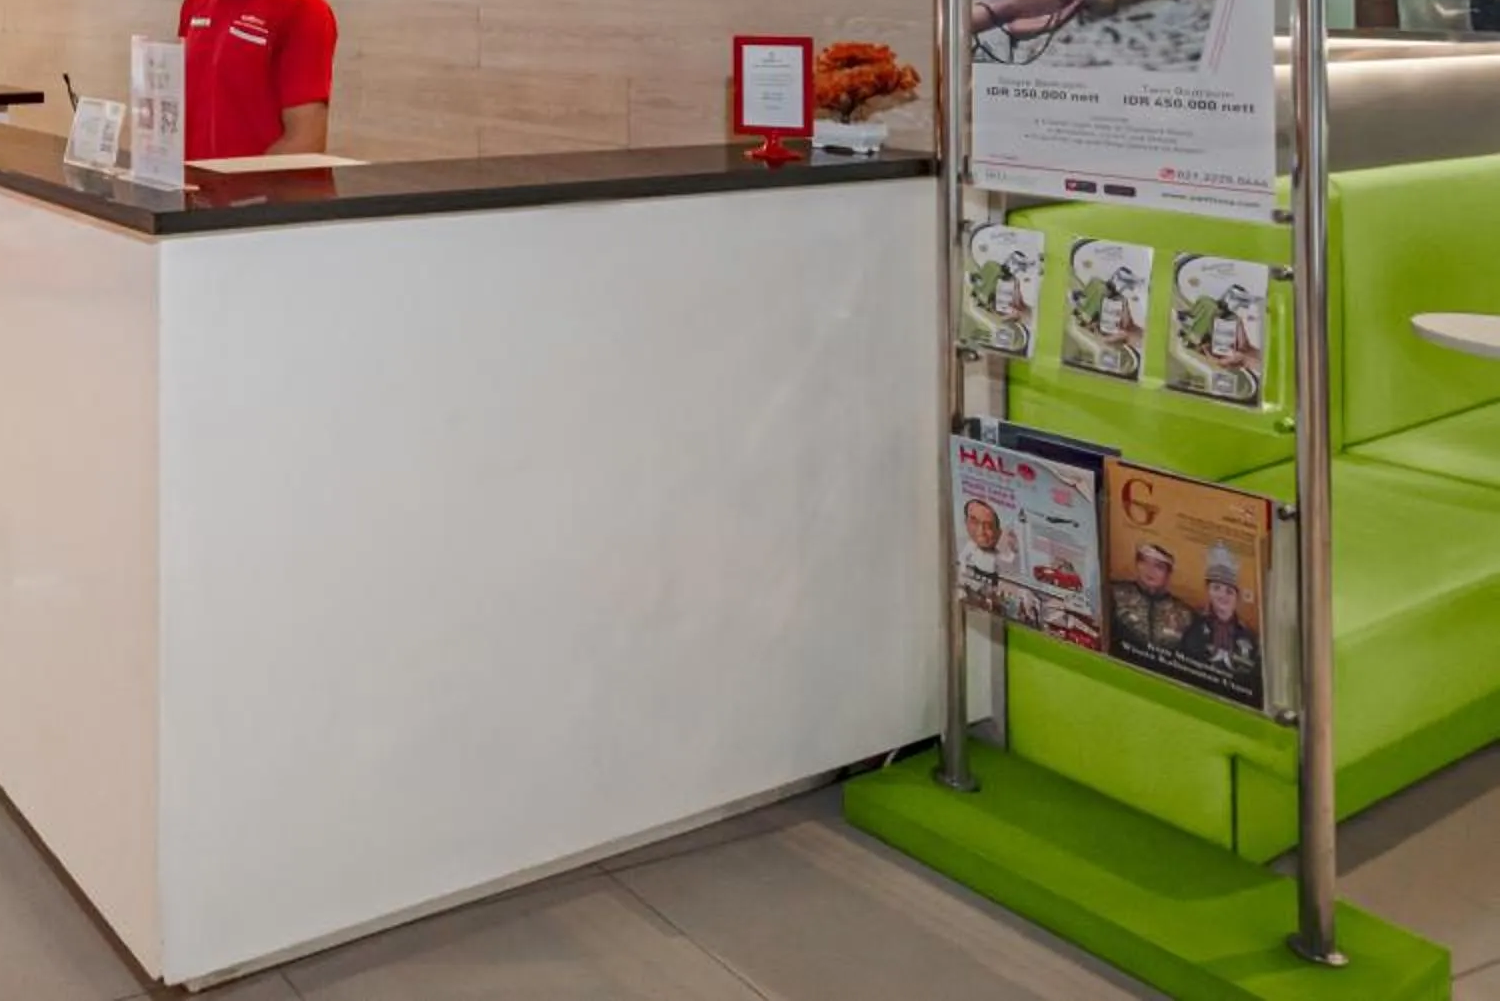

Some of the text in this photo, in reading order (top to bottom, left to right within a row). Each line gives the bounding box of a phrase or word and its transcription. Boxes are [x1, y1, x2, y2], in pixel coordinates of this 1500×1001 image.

[986, 86, 1010, 97] IDR
[1070, 93, 1100, 104] nett
[1123, 94, 1255, 114] IDR 450.000 nett
